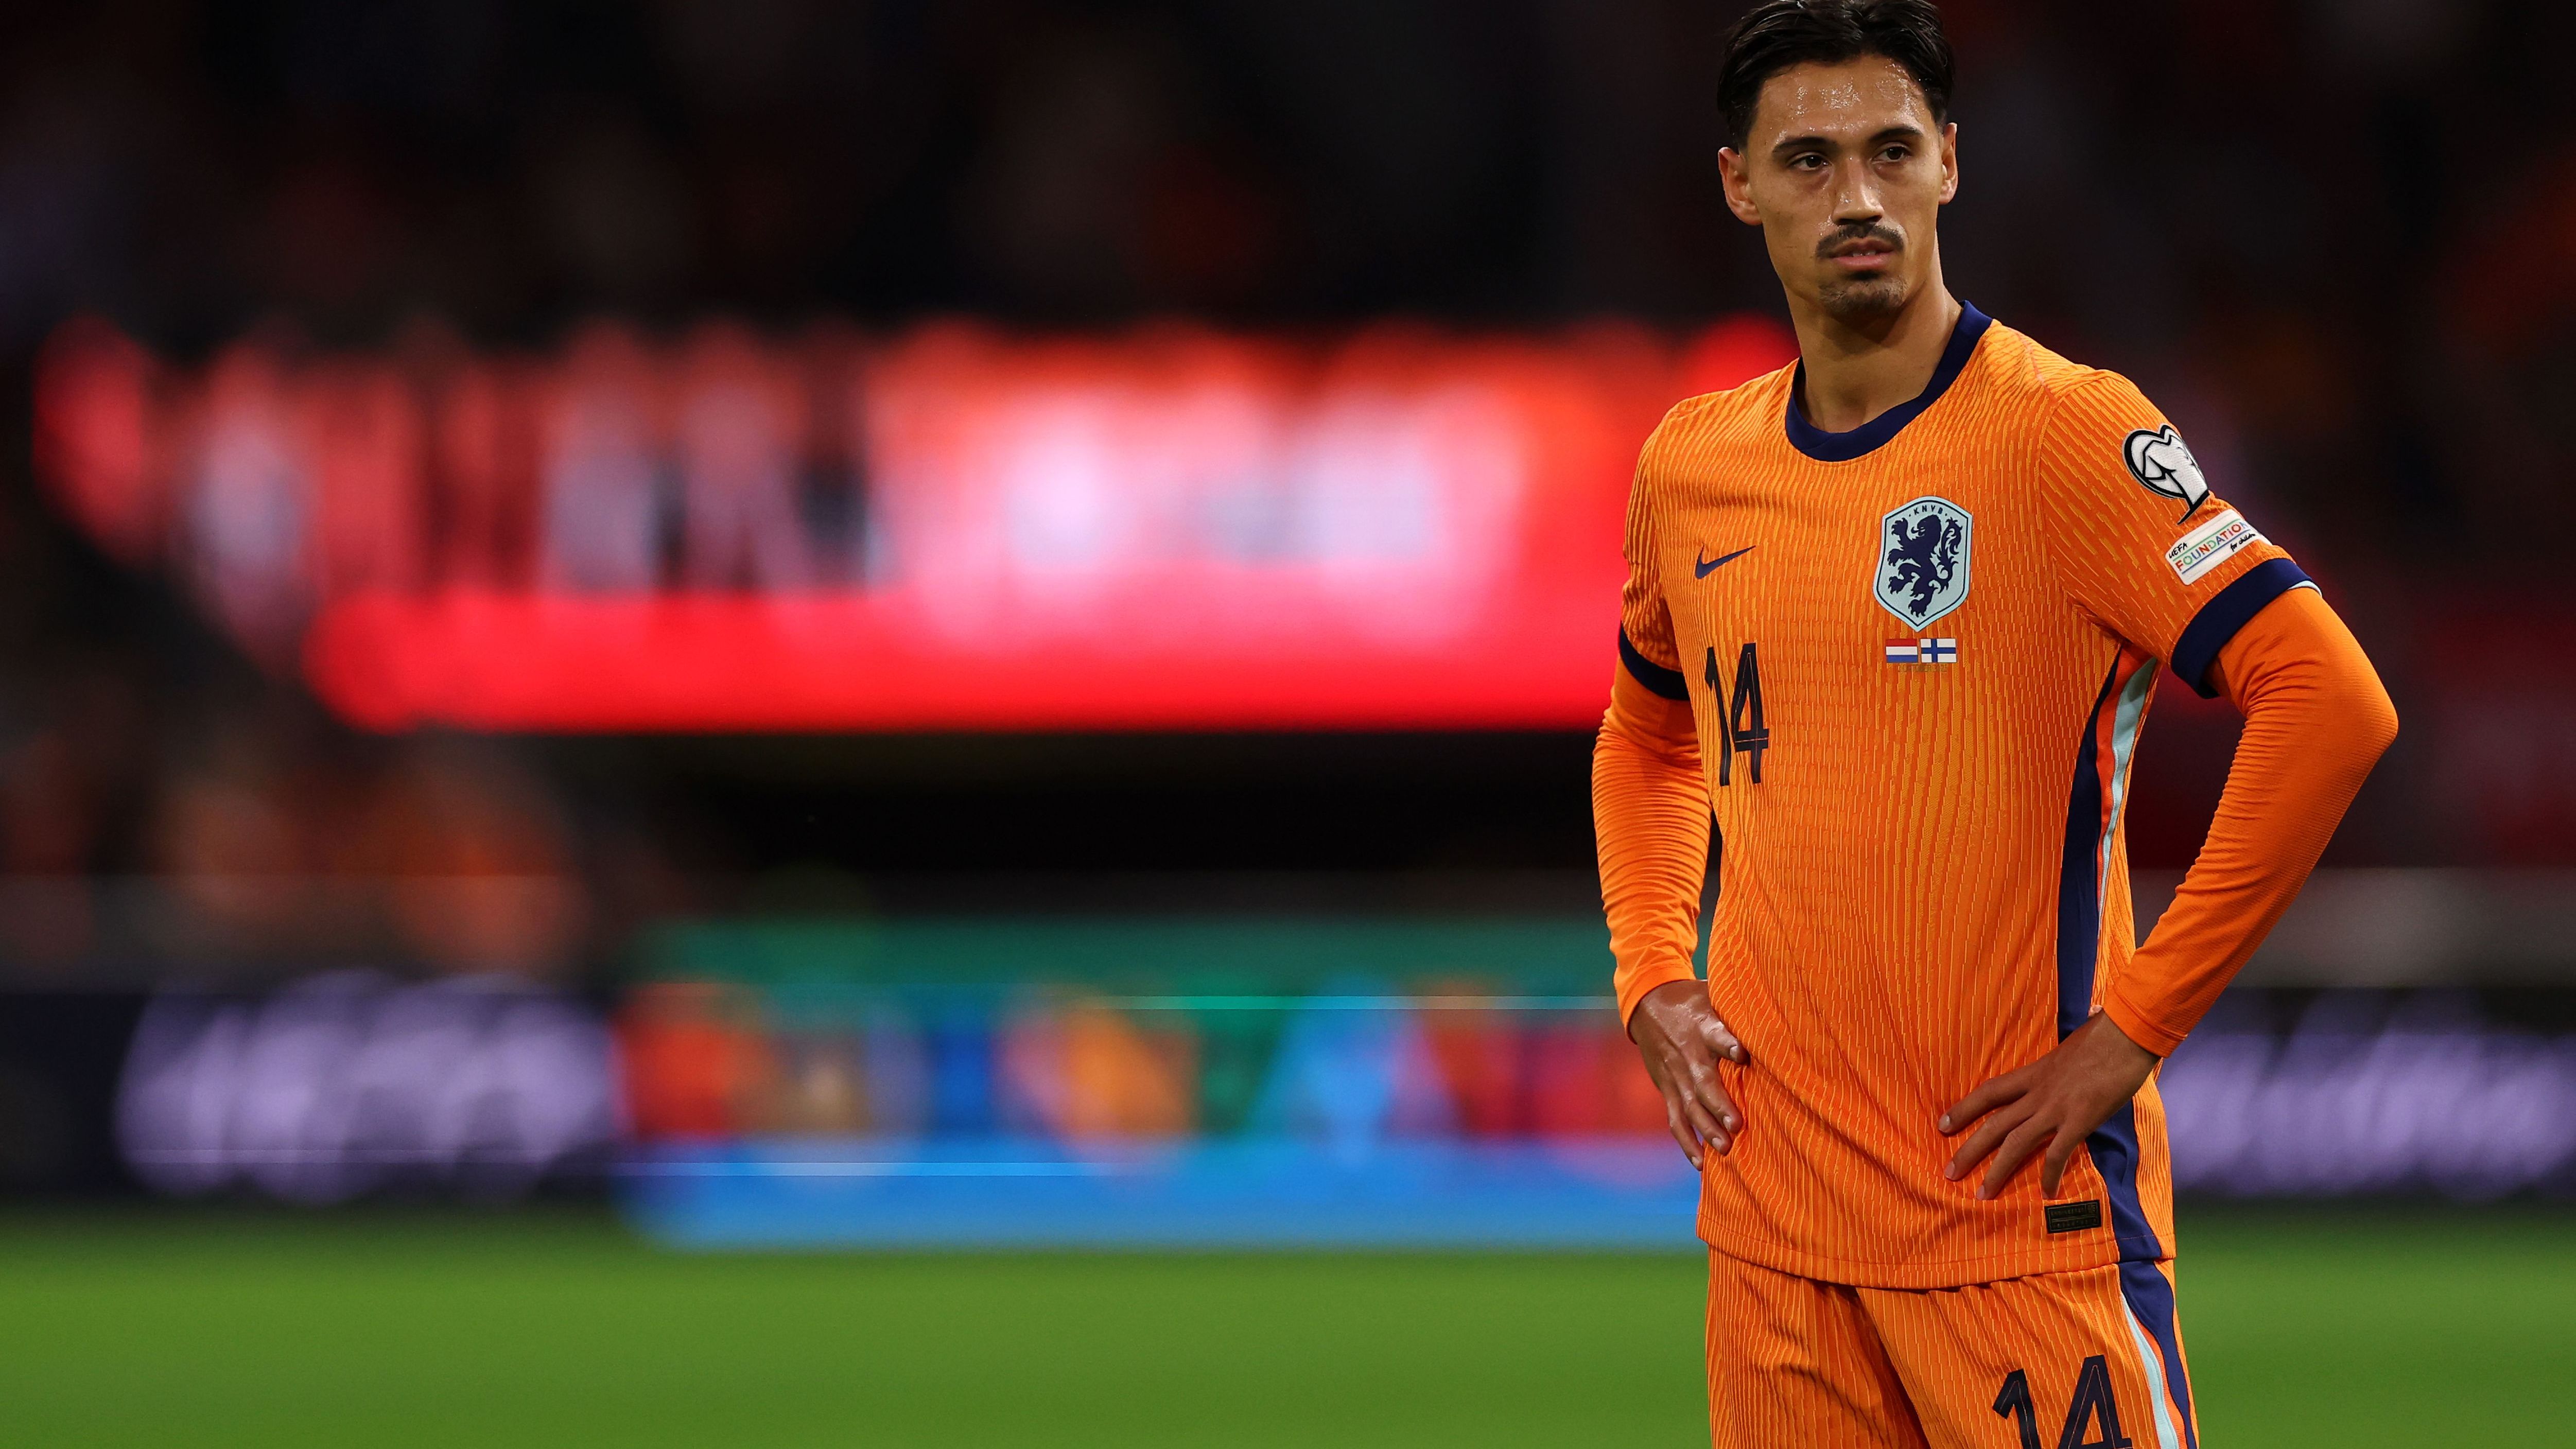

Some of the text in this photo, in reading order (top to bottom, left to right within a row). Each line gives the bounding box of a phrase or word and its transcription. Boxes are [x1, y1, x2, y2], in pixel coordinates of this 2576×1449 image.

[1913, 505, 1943, 515] KNVB
[2169, 542, 2187, 558] UEFA
[1704, 642, 1769, 787] 14
[1992, 1355, 2132, 1449] 14
